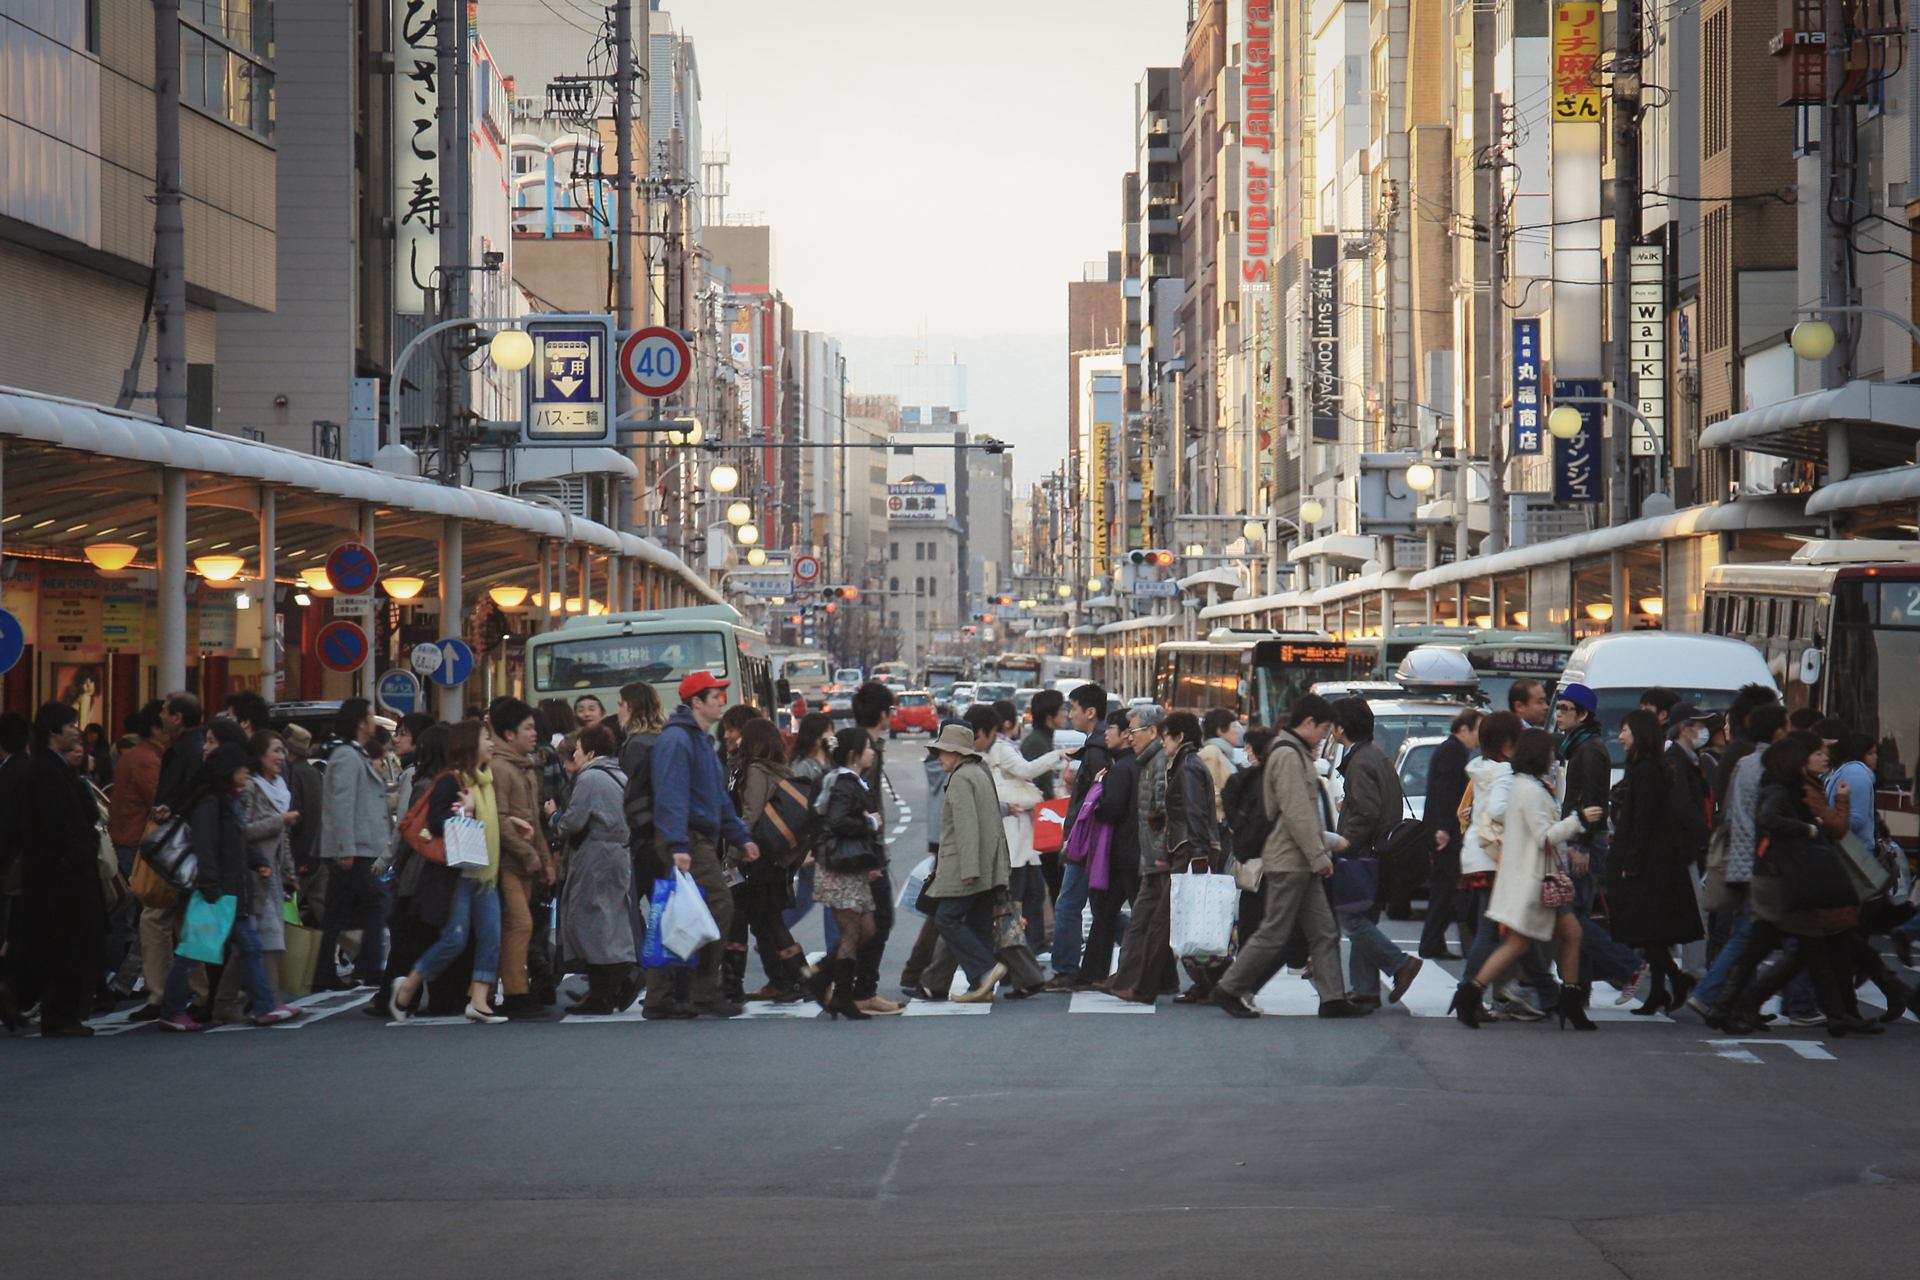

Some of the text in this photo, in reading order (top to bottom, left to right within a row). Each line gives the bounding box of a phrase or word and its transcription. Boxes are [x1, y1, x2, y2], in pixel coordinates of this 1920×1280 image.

[1557, 10, 1598, 95] リーチ麻雀
[1242, 0, 1270, 154] Jankara
[1556, 97, 1599, 117] さん
[1242, 160, 1270, 283] Super
[1318, 267, 1333, 417] THE SUIT COMPANY
[550, 360, 585, 376] 専用
[636, 346, 675, 378] 40
[536, 410, 599, 427] バス・二輪
[1517, 362, 1538, 451] 丸福商店
[799, 562, 815, 574] 40
[660, 644, 685, 670] 4
